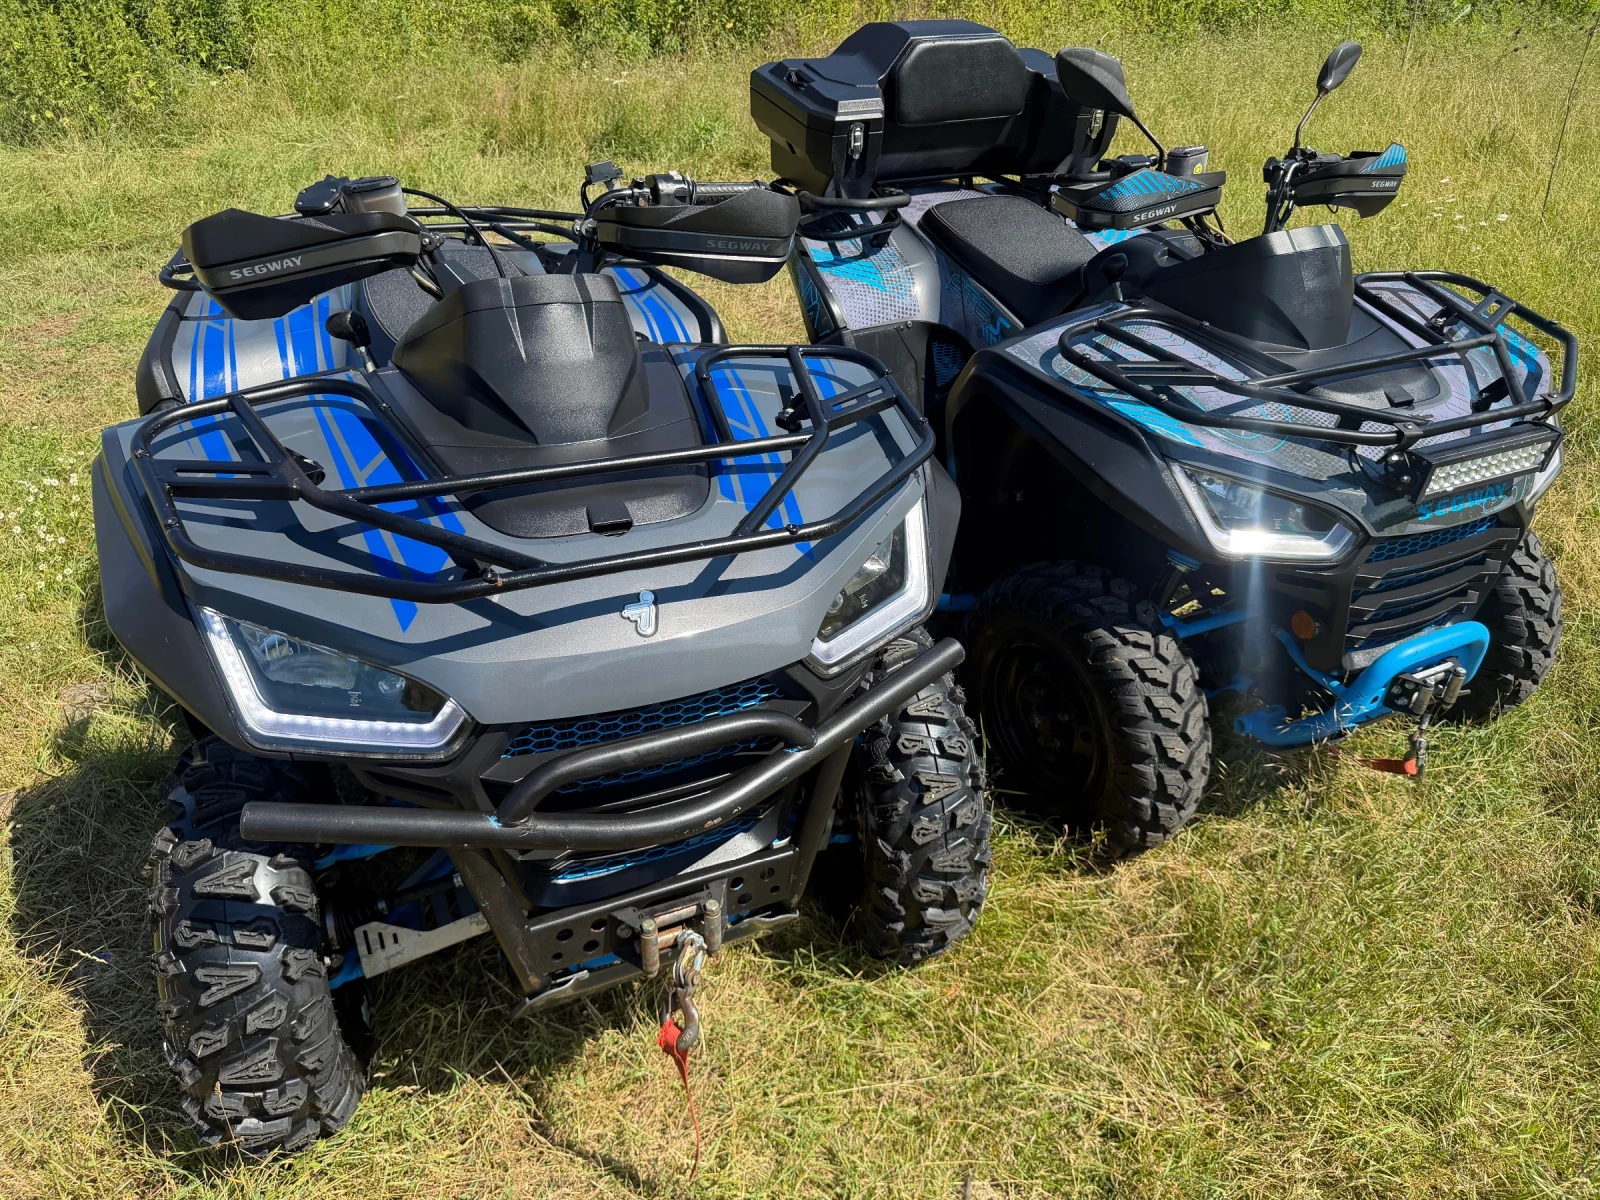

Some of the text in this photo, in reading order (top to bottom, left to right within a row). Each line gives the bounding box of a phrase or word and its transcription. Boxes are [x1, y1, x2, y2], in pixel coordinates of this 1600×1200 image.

[1370, 180, 1399, 188] SEGWAY
[1132, 204, 1178, 223] SEGWAY
[706, 239, 771, 252] SEGWAY
[229, 255, 302, 280] SEGWAY
[1417, 483, 1507, 521] SEGWAY
